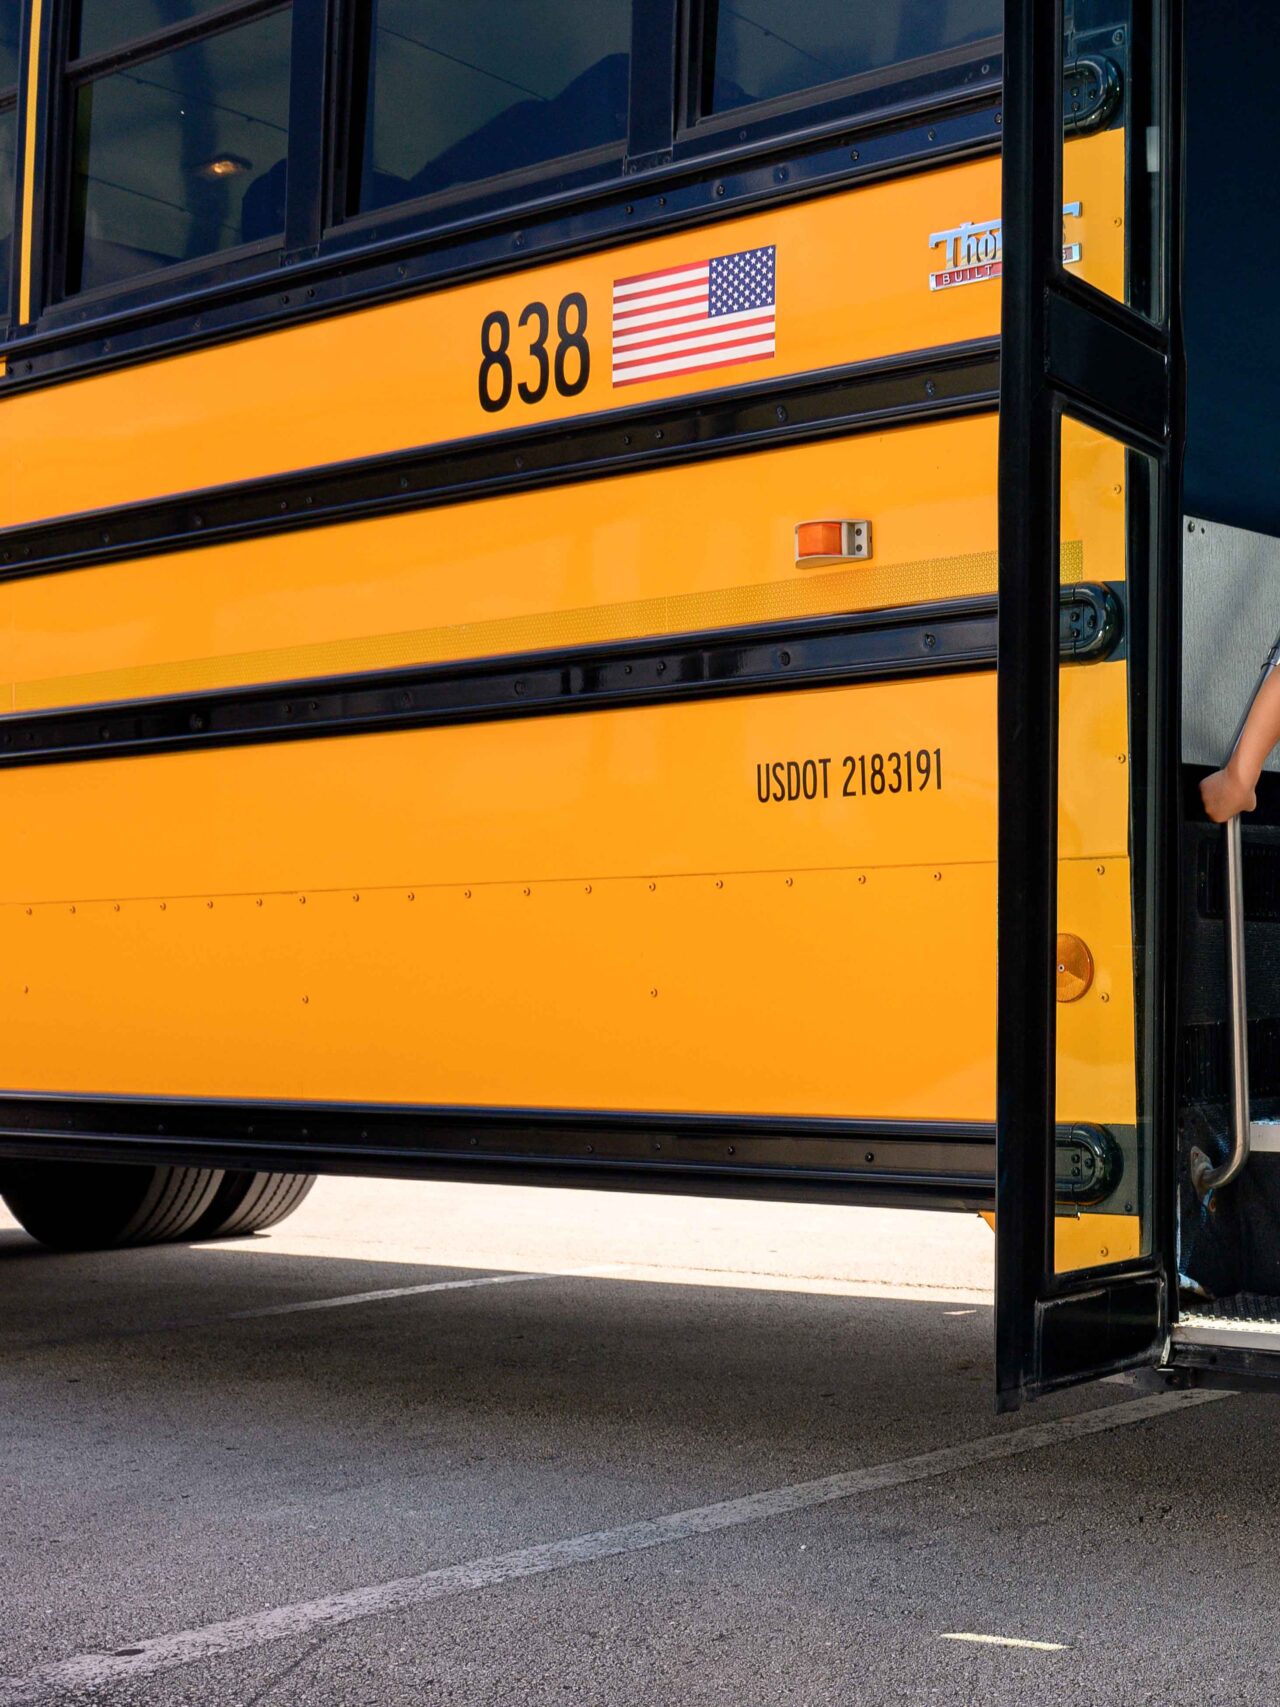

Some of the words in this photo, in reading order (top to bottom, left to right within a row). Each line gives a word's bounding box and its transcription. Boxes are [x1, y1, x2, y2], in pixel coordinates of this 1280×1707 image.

[942, 264, 993, 285] BUILT
[478, 292, 590, 412] 838
[757, 758, 831, 803] USDOT
[842, 748, 942, 797] 2183191
